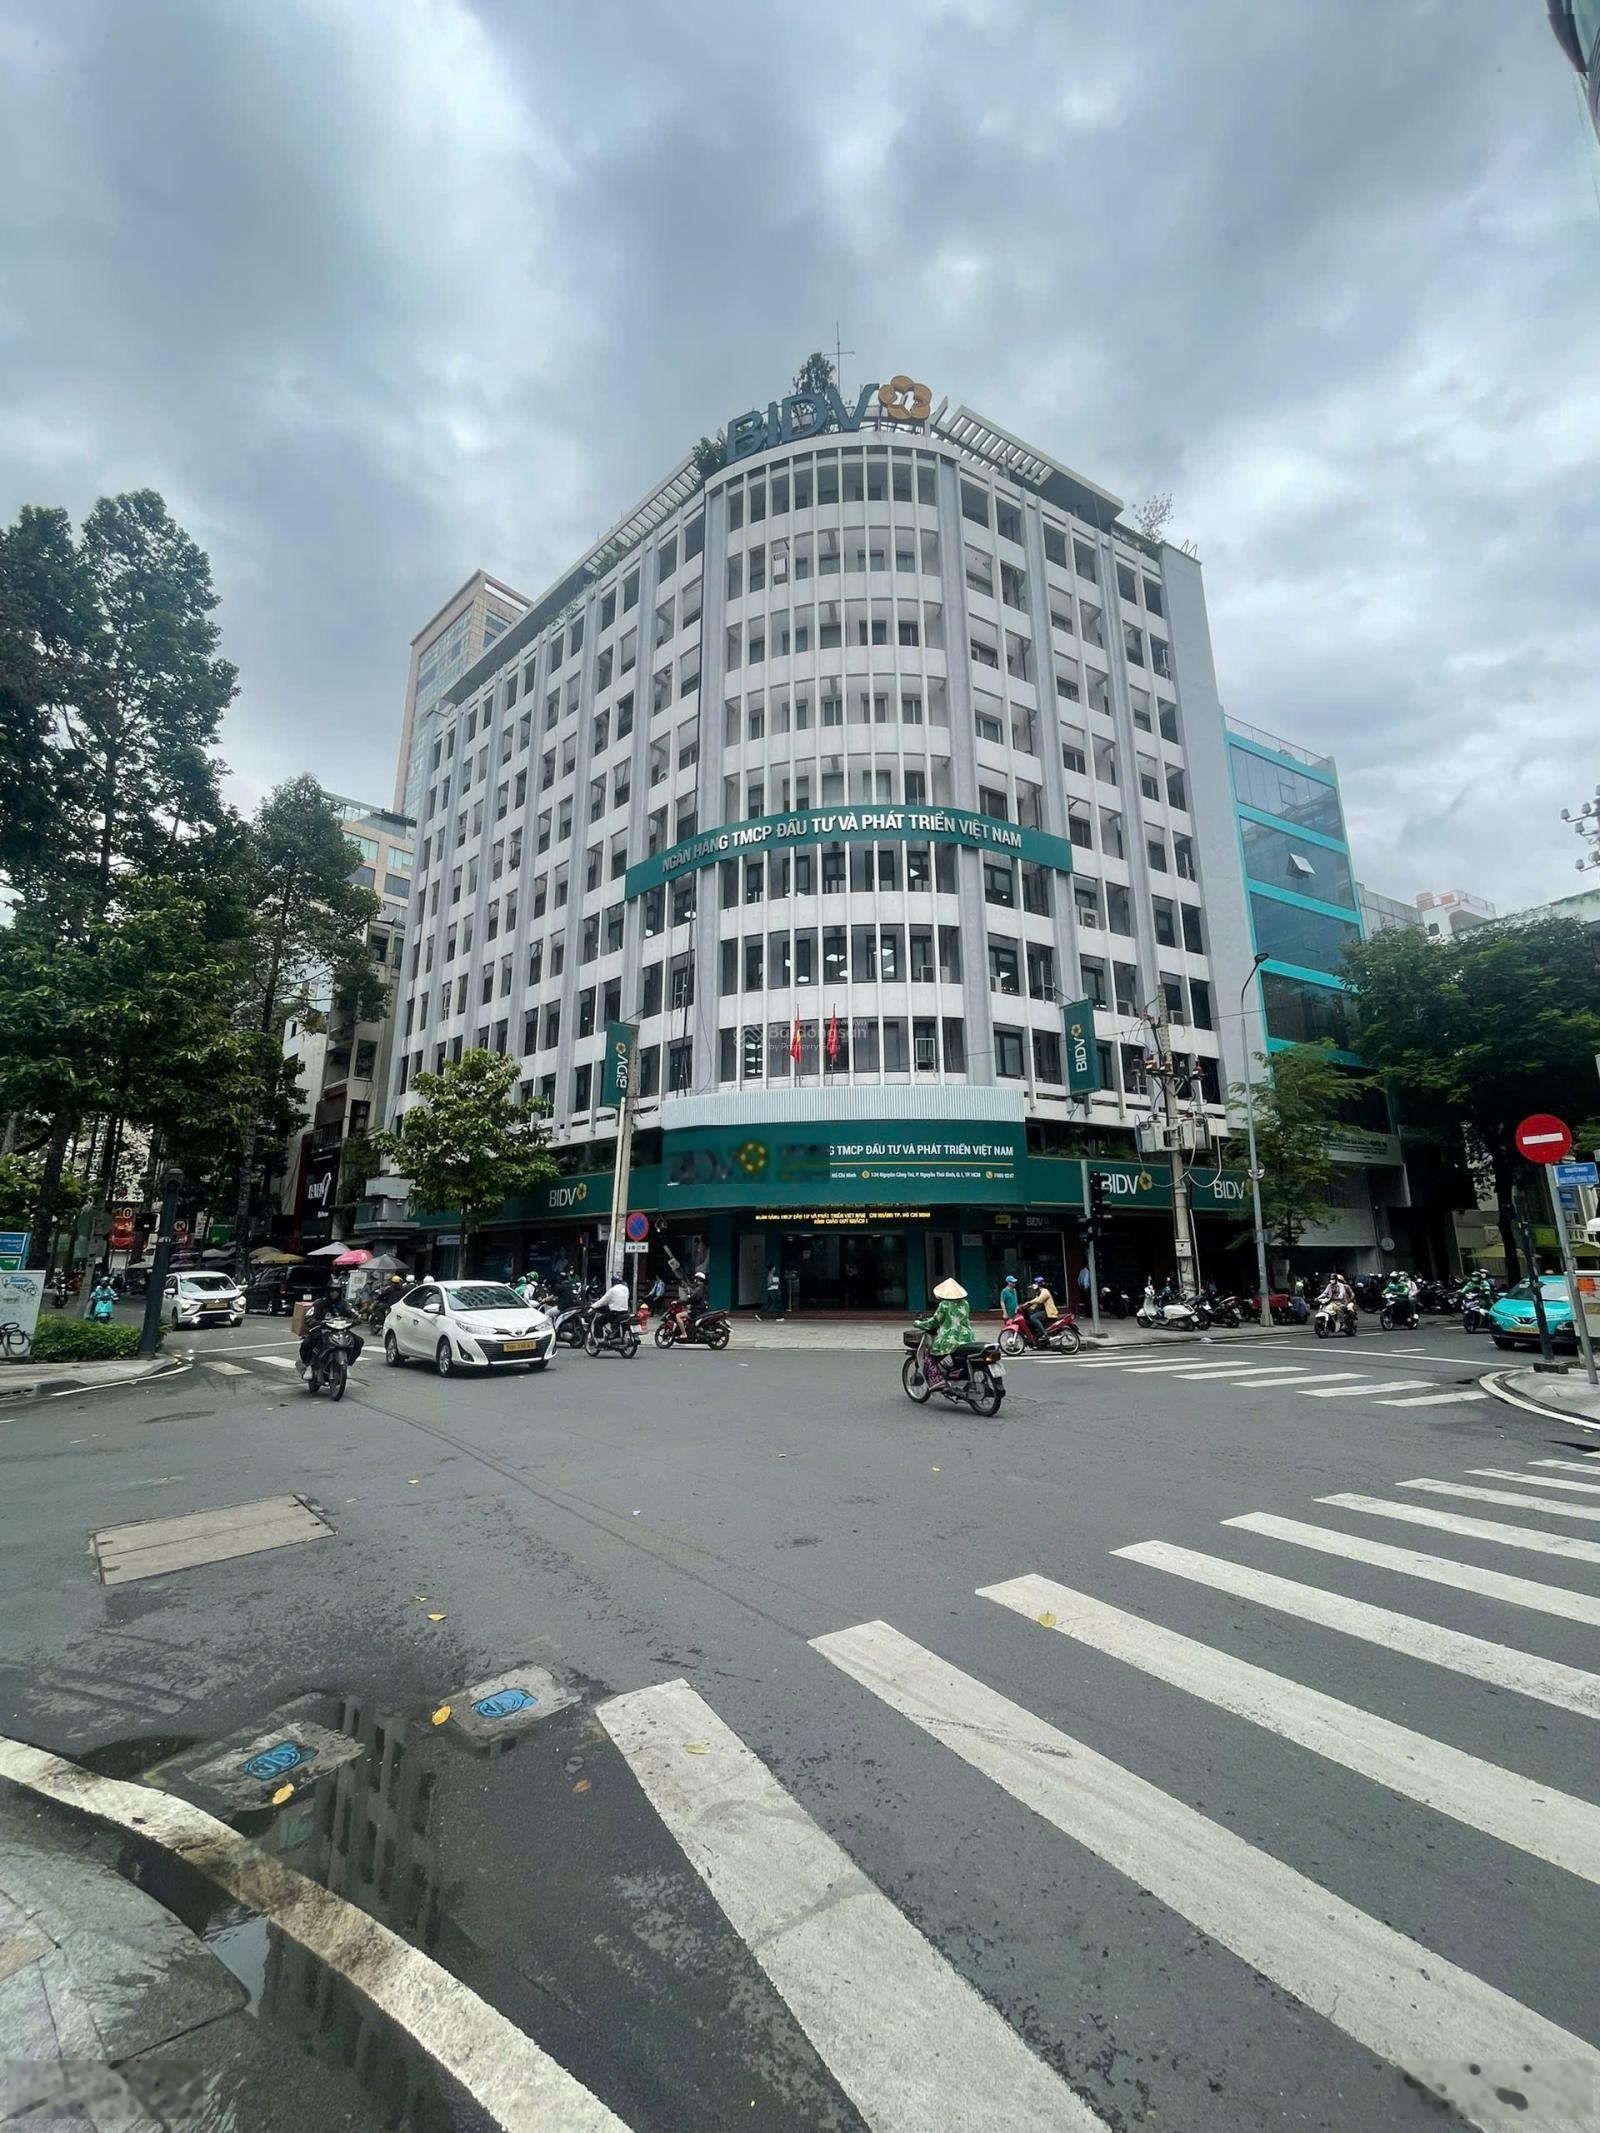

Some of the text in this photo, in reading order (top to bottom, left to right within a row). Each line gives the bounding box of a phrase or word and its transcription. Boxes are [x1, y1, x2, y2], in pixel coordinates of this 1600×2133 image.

[727, 383, 880, 466] BIDV
[662, 810, 1022, 873] NGÂN HÀNG TMCP ĐẦU TƯ VÀ PHÁT TRIỂN VIỆT NAM
[1073, 1037, 1088, 1073] BIDV
[615, 1053, 629, 1089] BIDV
[837, 1145, 863, 1155] TMCP
[866, 1143, 886, 1155] ĐẦU
[887, 1143, 902, 1155] TƯ
[902, 1143, 916, 1155] VÀ
[917, 1143, 942, 1155] PHÁT
[943, 1142, 971, 1155] TRIỂN
[972, 1143, 992, 1157] VIỆT
[994, 1146, 1014, 1157] NAM
[548, 1186, 578, 1208] BIDV
[1101, 1172, 1139, 1195] BIDV
[1213, 1180, 1245, 1200] BIDV
